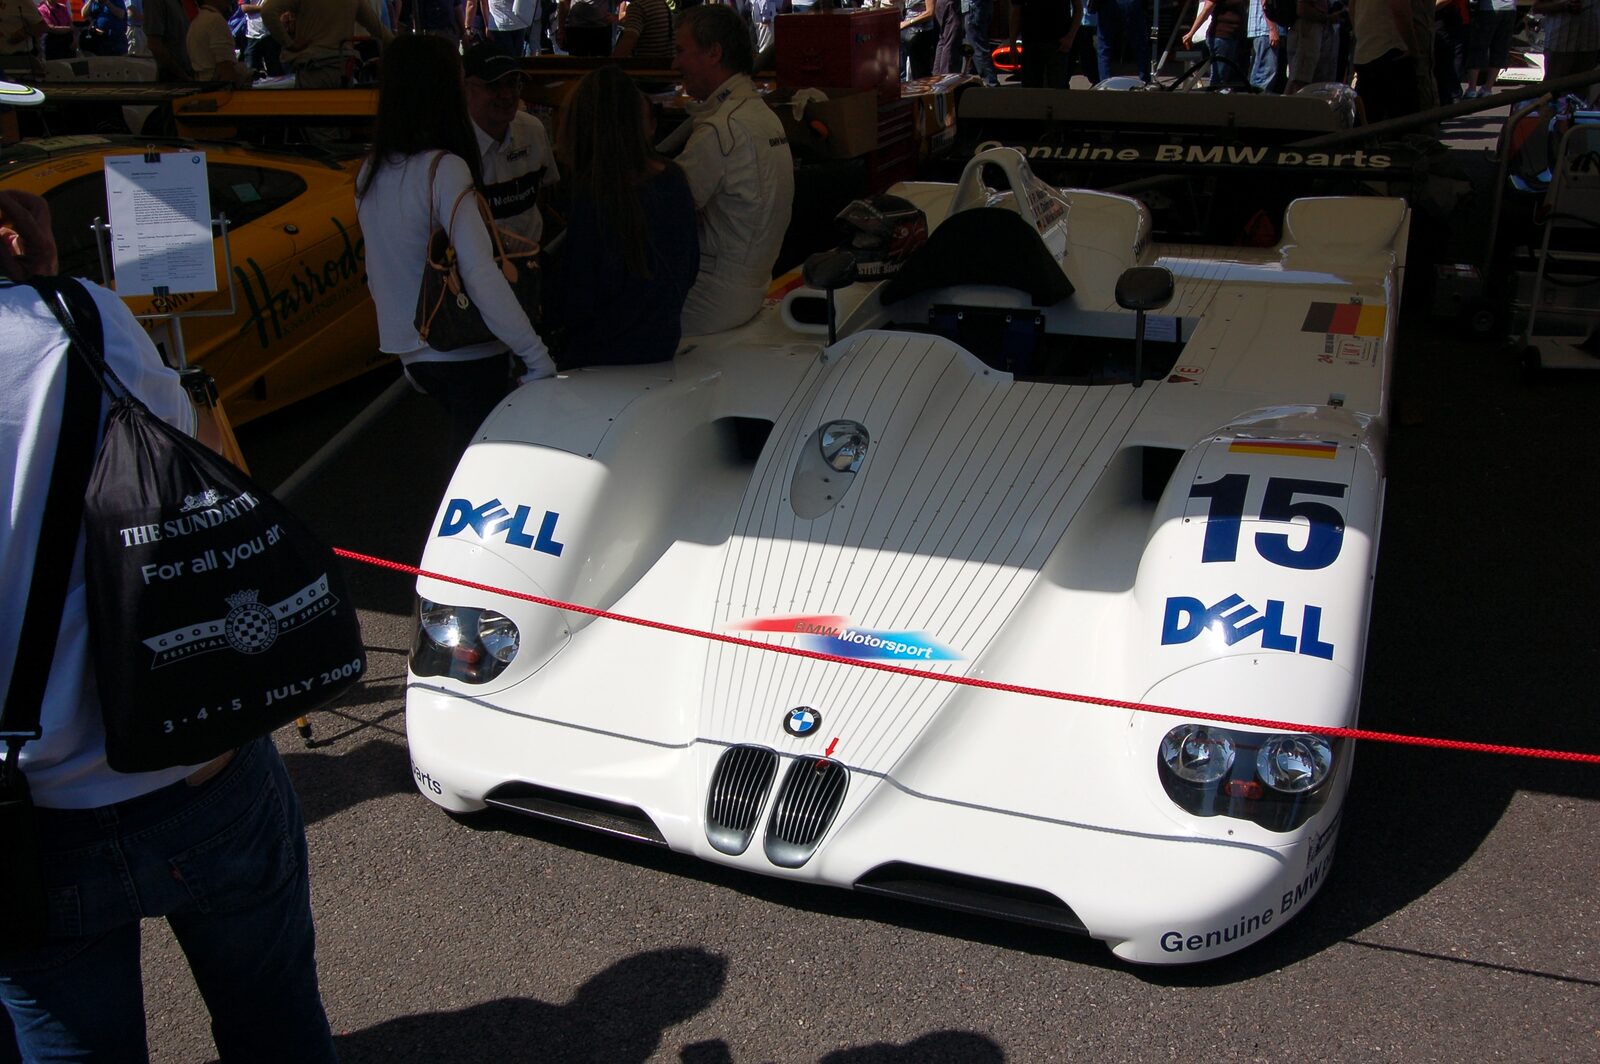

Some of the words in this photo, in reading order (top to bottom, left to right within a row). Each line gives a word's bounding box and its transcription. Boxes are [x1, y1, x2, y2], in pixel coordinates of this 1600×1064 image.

[1155, 144, 1269, 164] BMW
[1277, 149, 1392, 168] parts
[120, 523, 163, 547] THE
[164, 498, 242, 538] SUNDAY
[437, 498, 565, 557] DELL
[1188, 473, 1349, 570] 15
[141, 561, 185, 585] For
[192, 549, 218, 574] all
[222, 537, 265, 569] you
[163, 638, 225, 660] FESTIVAL
[282, 617, 295, 628] OF
[300, 598, 330, 619] SPEED
[794, 621, 838, 637] BMW
[837, 629, 933, 659] Motorsport
[1161, 593, 1335, 661] DELL
[162, 719, 174, 734] 3
[196, 707, 208, 720] 4
[231, 698, 242, 711] 5
[265, 677, 314, 706] JULY
[320, 658, 362, 686] 2009
[1160, 908, 1274, 953] Genuine
[1280, 860, 1323, 915] BMW
